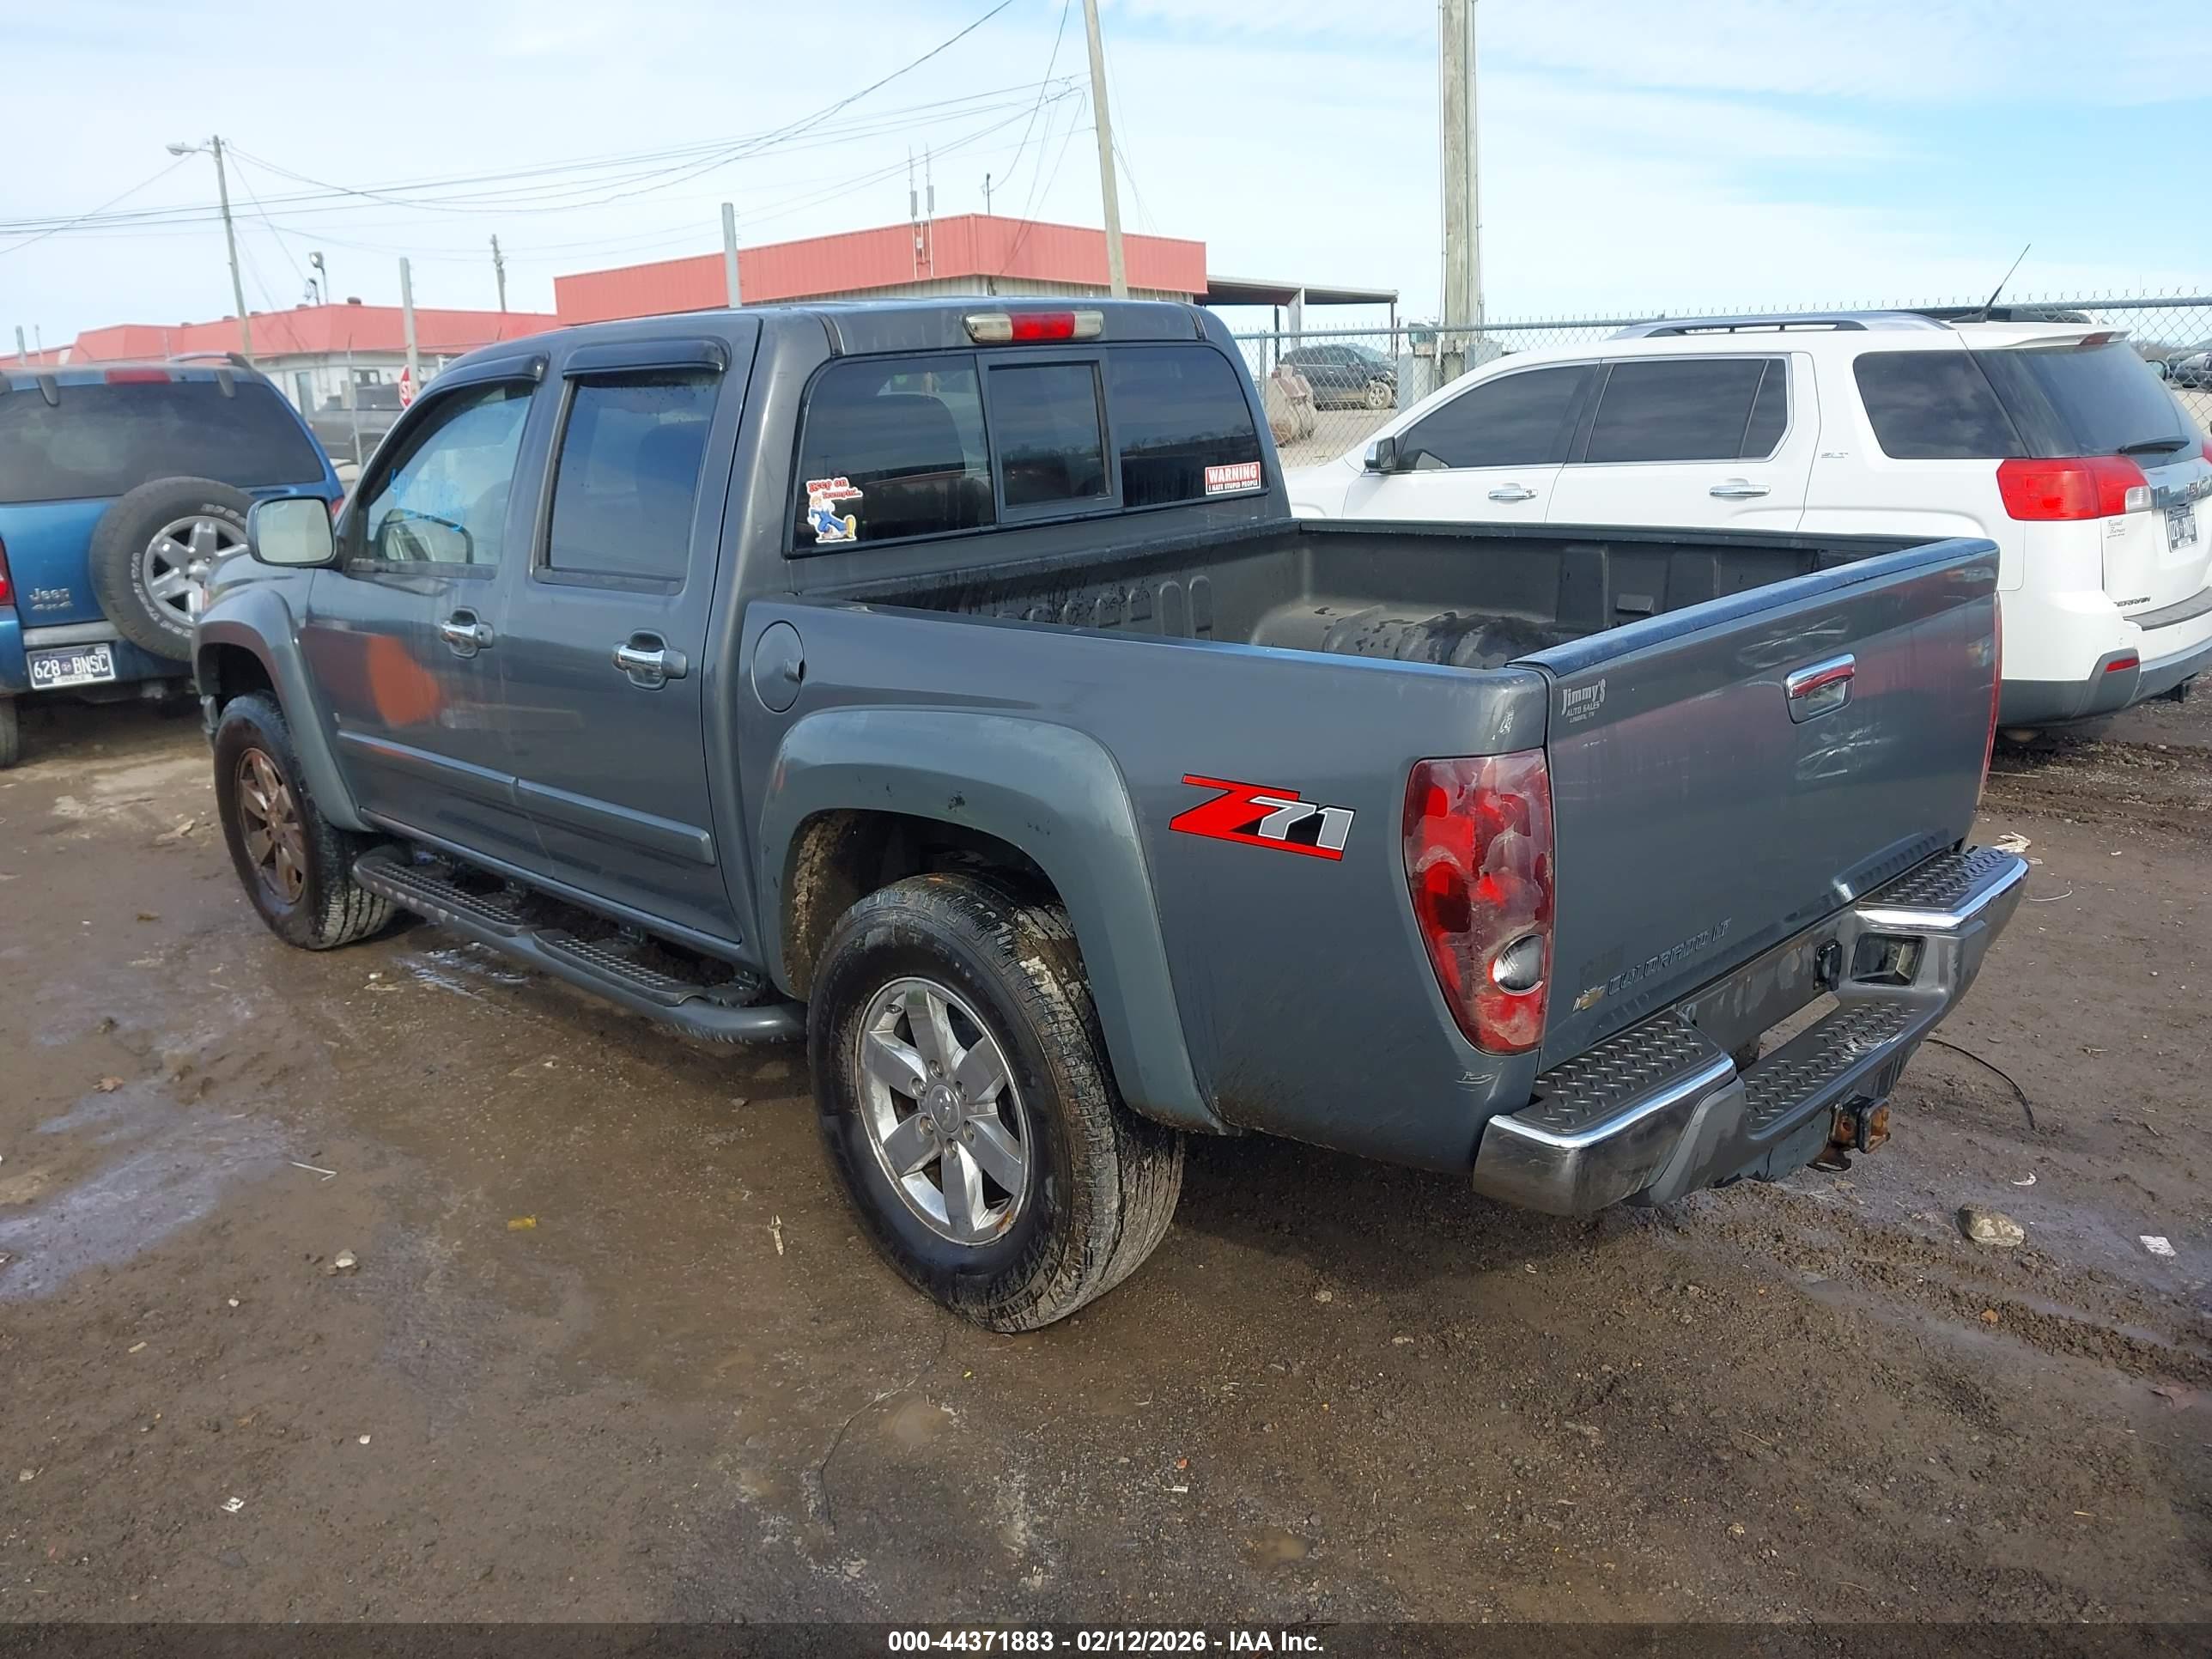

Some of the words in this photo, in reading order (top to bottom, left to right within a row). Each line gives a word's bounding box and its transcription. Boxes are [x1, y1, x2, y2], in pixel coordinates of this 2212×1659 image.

[1207, 465, 1257, 483] WARNING
[808, 481, 832, 493] Keep
[834, 479, 848, 488] on
[1212, 483, 1224, 491] HATE
[1224, 481, 1241, 489] STUPID
[1242, 478, 1258, 488] PEOPLE
[29, 587, 70, 602] Jeep
[33, 659, 61, 679] 628
[71, 653, 109, 674] BNSC
[1565, 706, 1582, 718] AUTO
[1583, 701, 1601, 712] SALES
[1169, 773, 1356, 861] Z71
[1607, 930, 1709, 996] COLORADO
